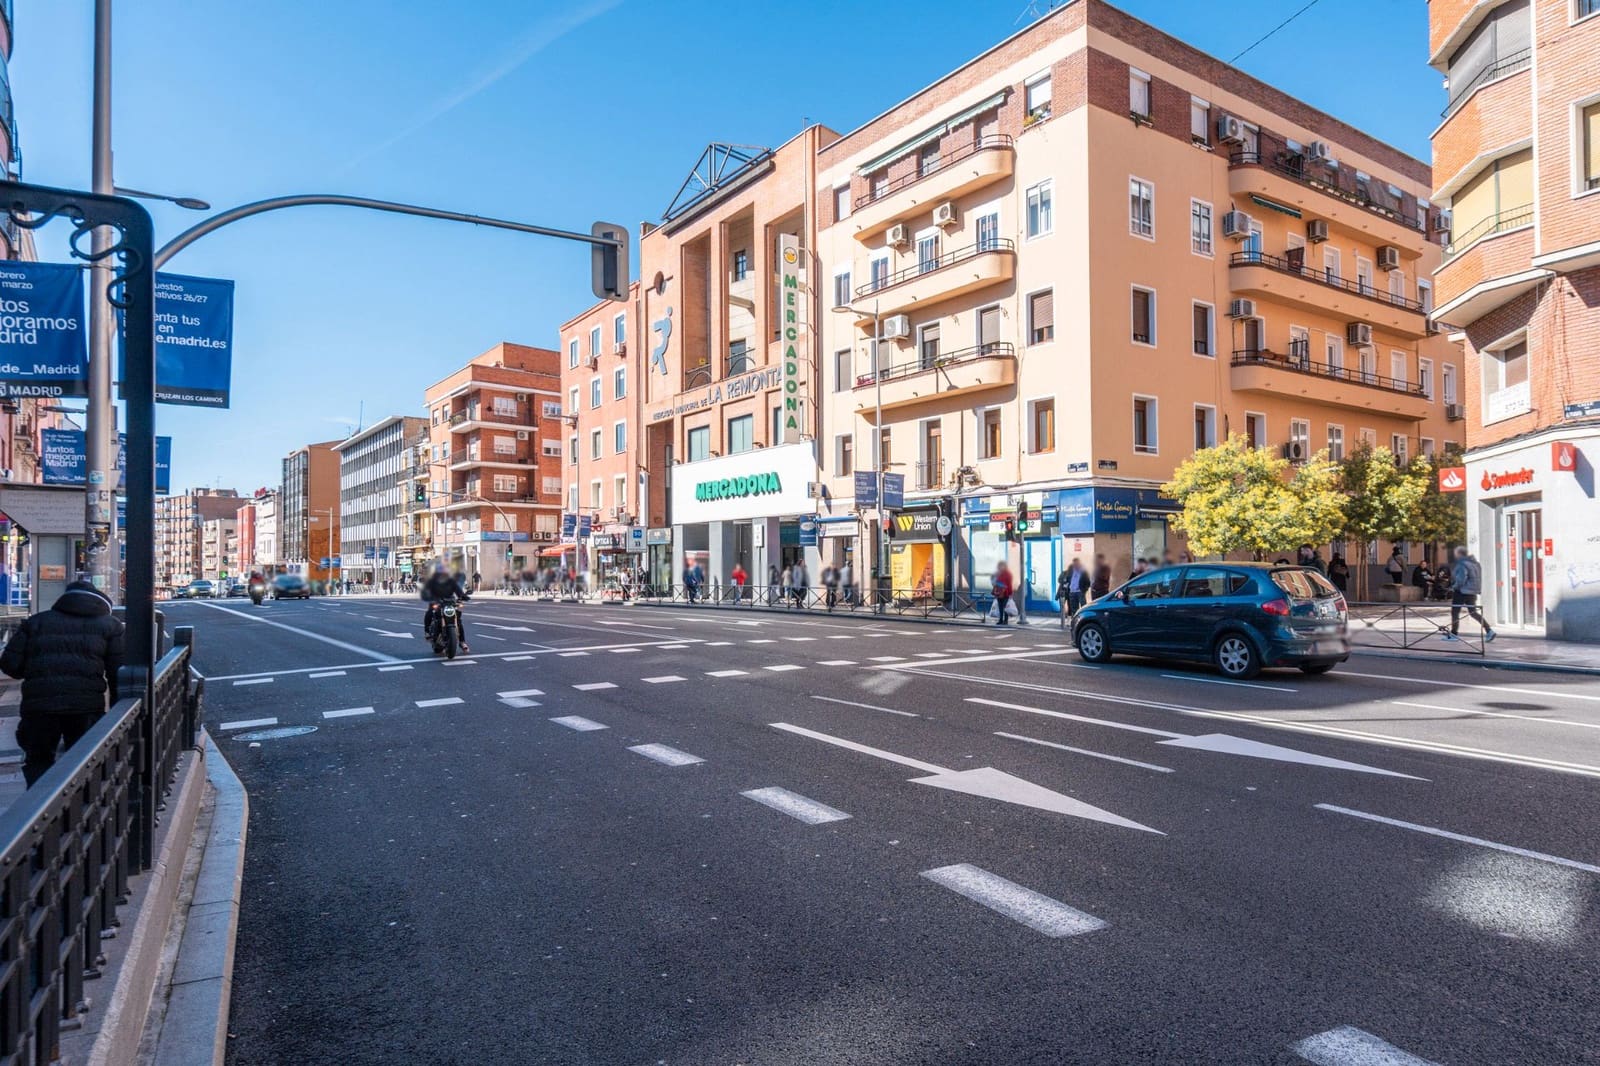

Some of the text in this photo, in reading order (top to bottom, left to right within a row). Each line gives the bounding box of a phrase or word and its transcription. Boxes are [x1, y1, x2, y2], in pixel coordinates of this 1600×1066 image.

[2, 281, 33, 290] marzo
[183, 293, 208, 304] 26/27
[182, 314, 200, 326] tus
[158, 324, 174, 334] en
[156, 334, 227, 349] e.madrid.es
[784, 274, 798, 429] MERCADONA
[9, 385, 63, 397] MADRID
[706, 387, 723, 405] LA
[45, 453, 86, 462] mejoram
[696, 472, 782, 502] MERCADONA
[914, 515, 937, 523] Western
